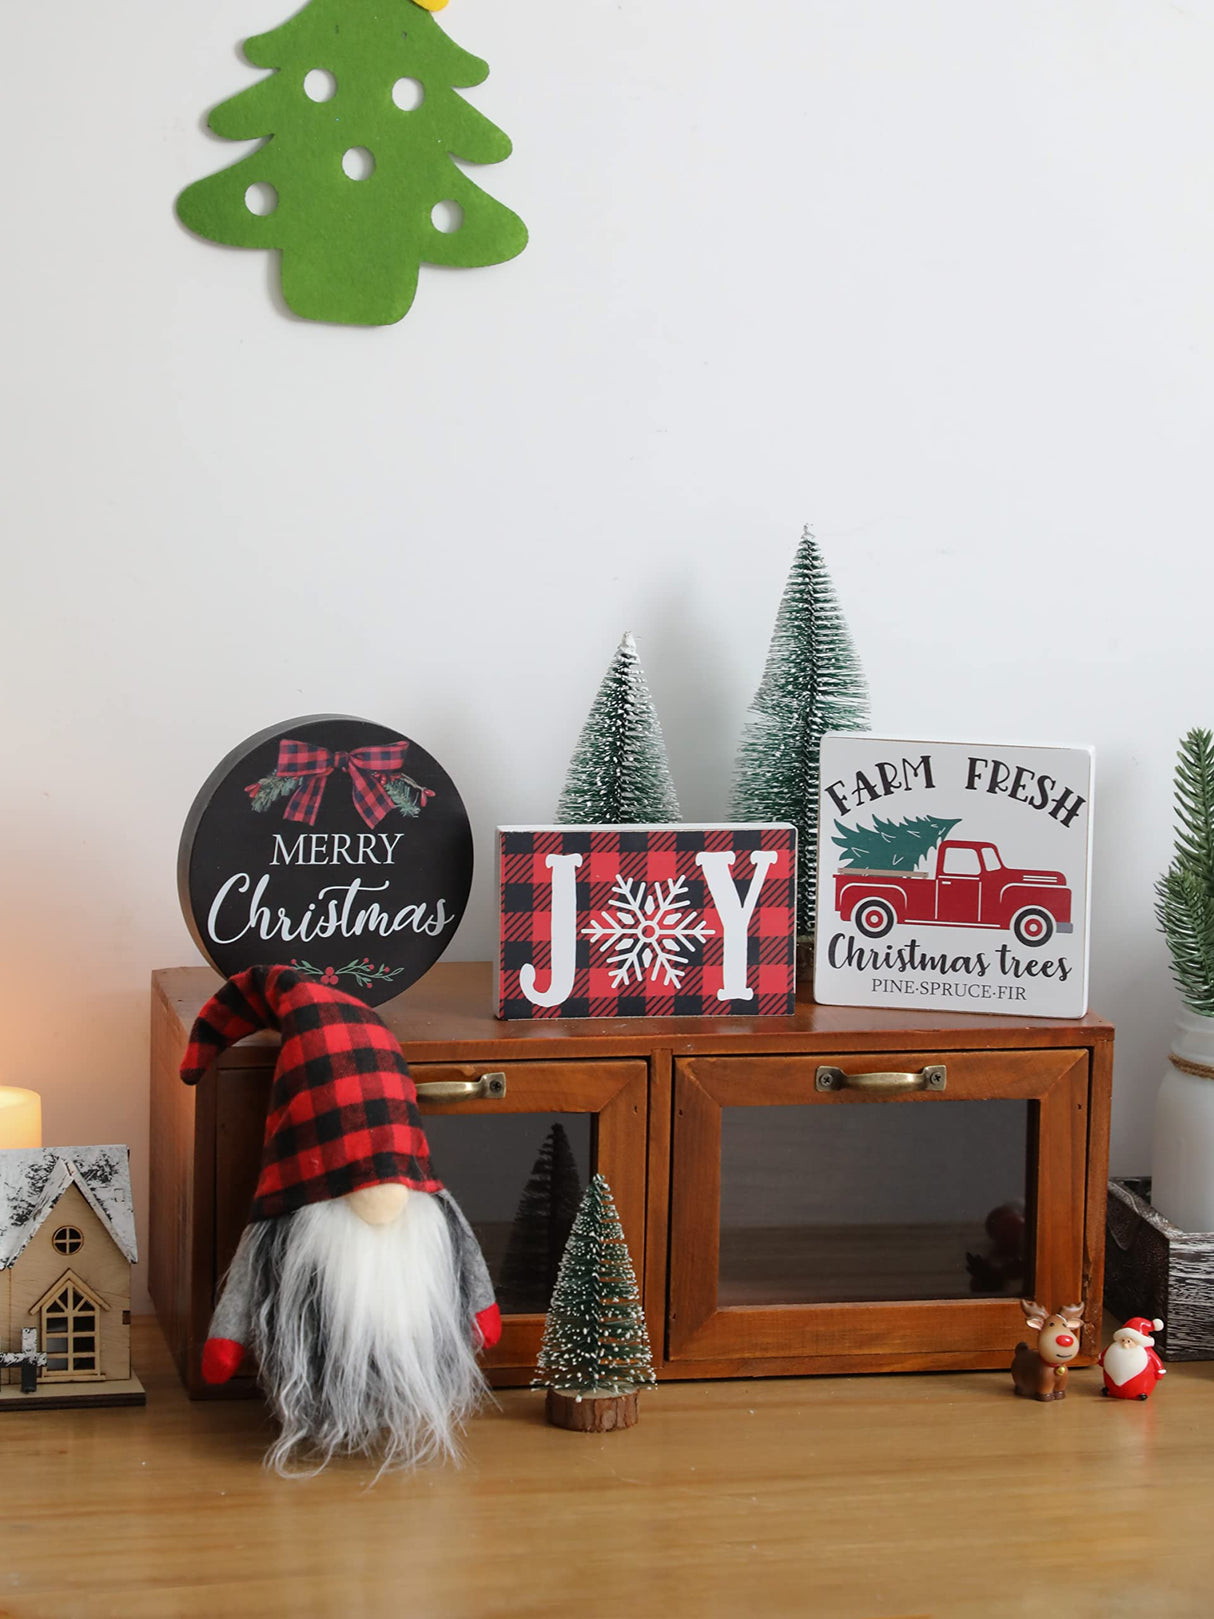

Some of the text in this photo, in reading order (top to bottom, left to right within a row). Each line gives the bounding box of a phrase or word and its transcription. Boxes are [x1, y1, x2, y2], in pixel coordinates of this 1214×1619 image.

[824, 755, 1086, 828] FARM FRESH
[269, 833, 404, 865] MERRY
[207, 872, 455, 944] Christmas
[827, 932, 1073, 982] Christmas trees
